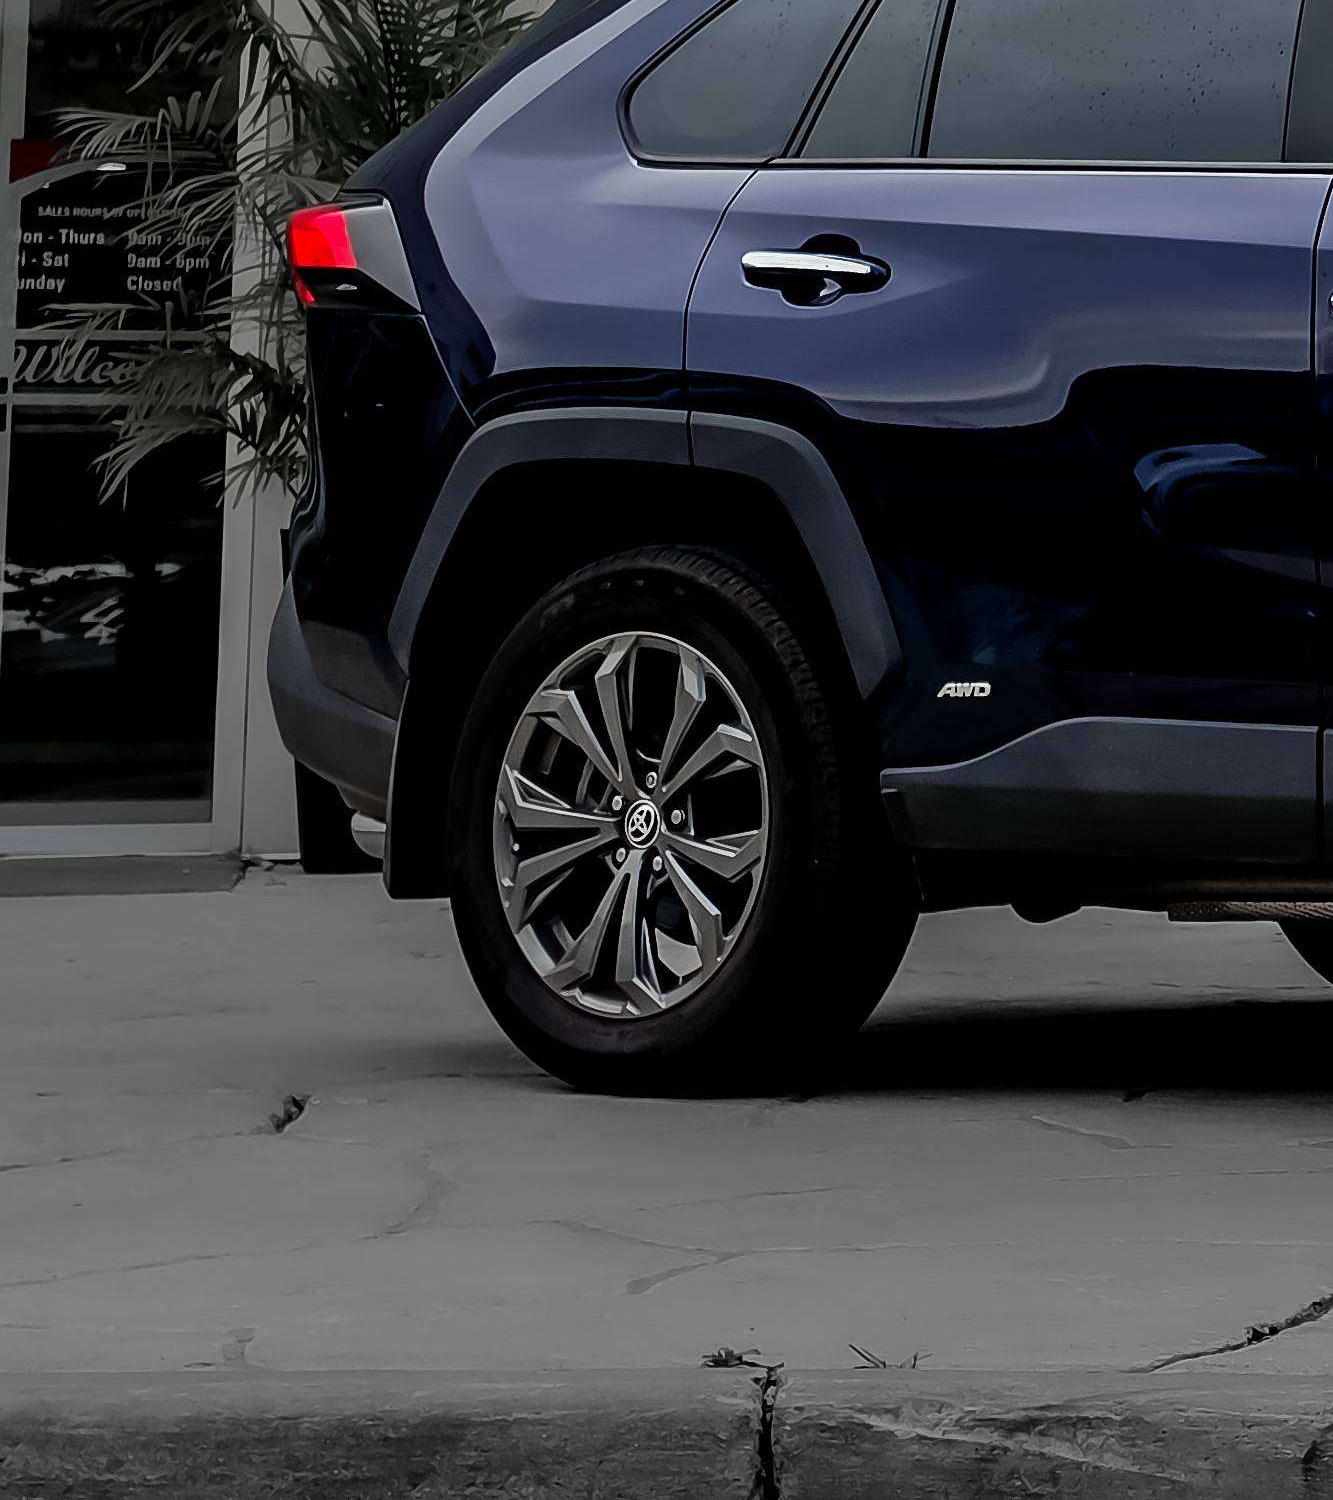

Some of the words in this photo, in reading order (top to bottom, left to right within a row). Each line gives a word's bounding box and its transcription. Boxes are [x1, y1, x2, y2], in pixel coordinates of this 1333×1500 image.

[22, 231, 43, 244] on
[59, 228, 105, 244] Thurs
[43, 250, 69, 268] Sat
[127, 252, 161, 268] 9am
[18, 274, 66, 293] unday
[937, 682, 992, 698] AWD
